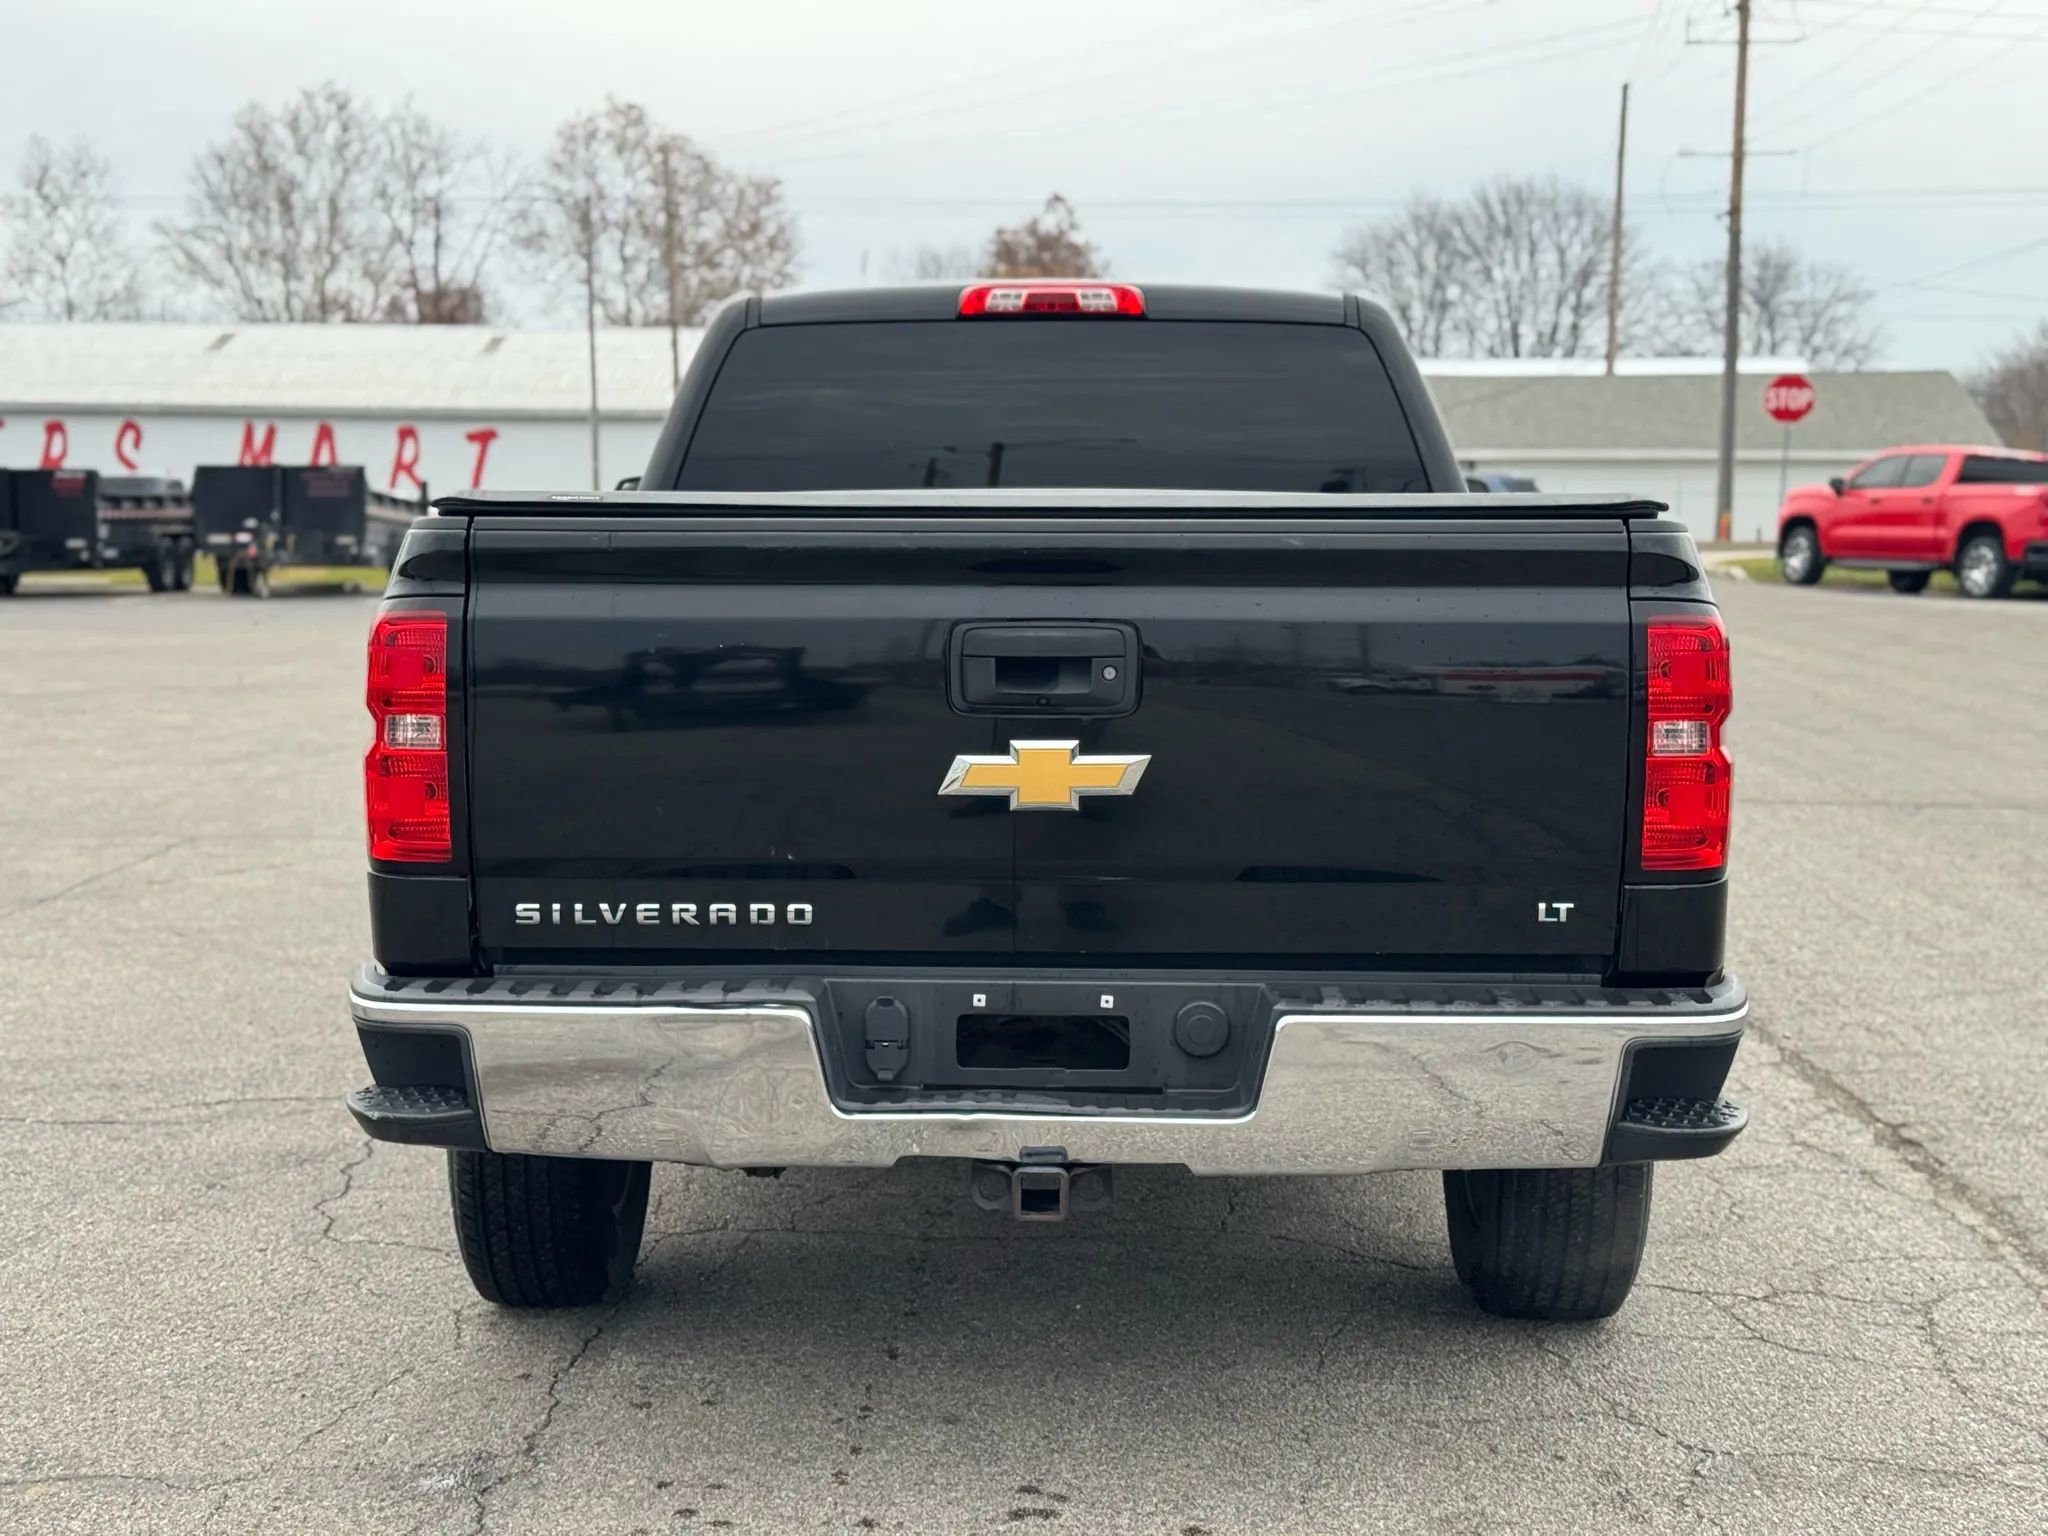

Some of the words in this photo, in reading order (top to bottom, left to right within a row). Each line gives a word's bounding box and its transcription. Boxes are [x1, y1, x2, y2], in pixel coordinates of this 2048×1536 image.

[1765, 386, 1813, 410] STOP
[0, 418, 142, 472] RS
[238, 420, 498, 490] MART
[514, 902, 814, 926] SILVERADO
[1537, 902, 1575, 922] LT
